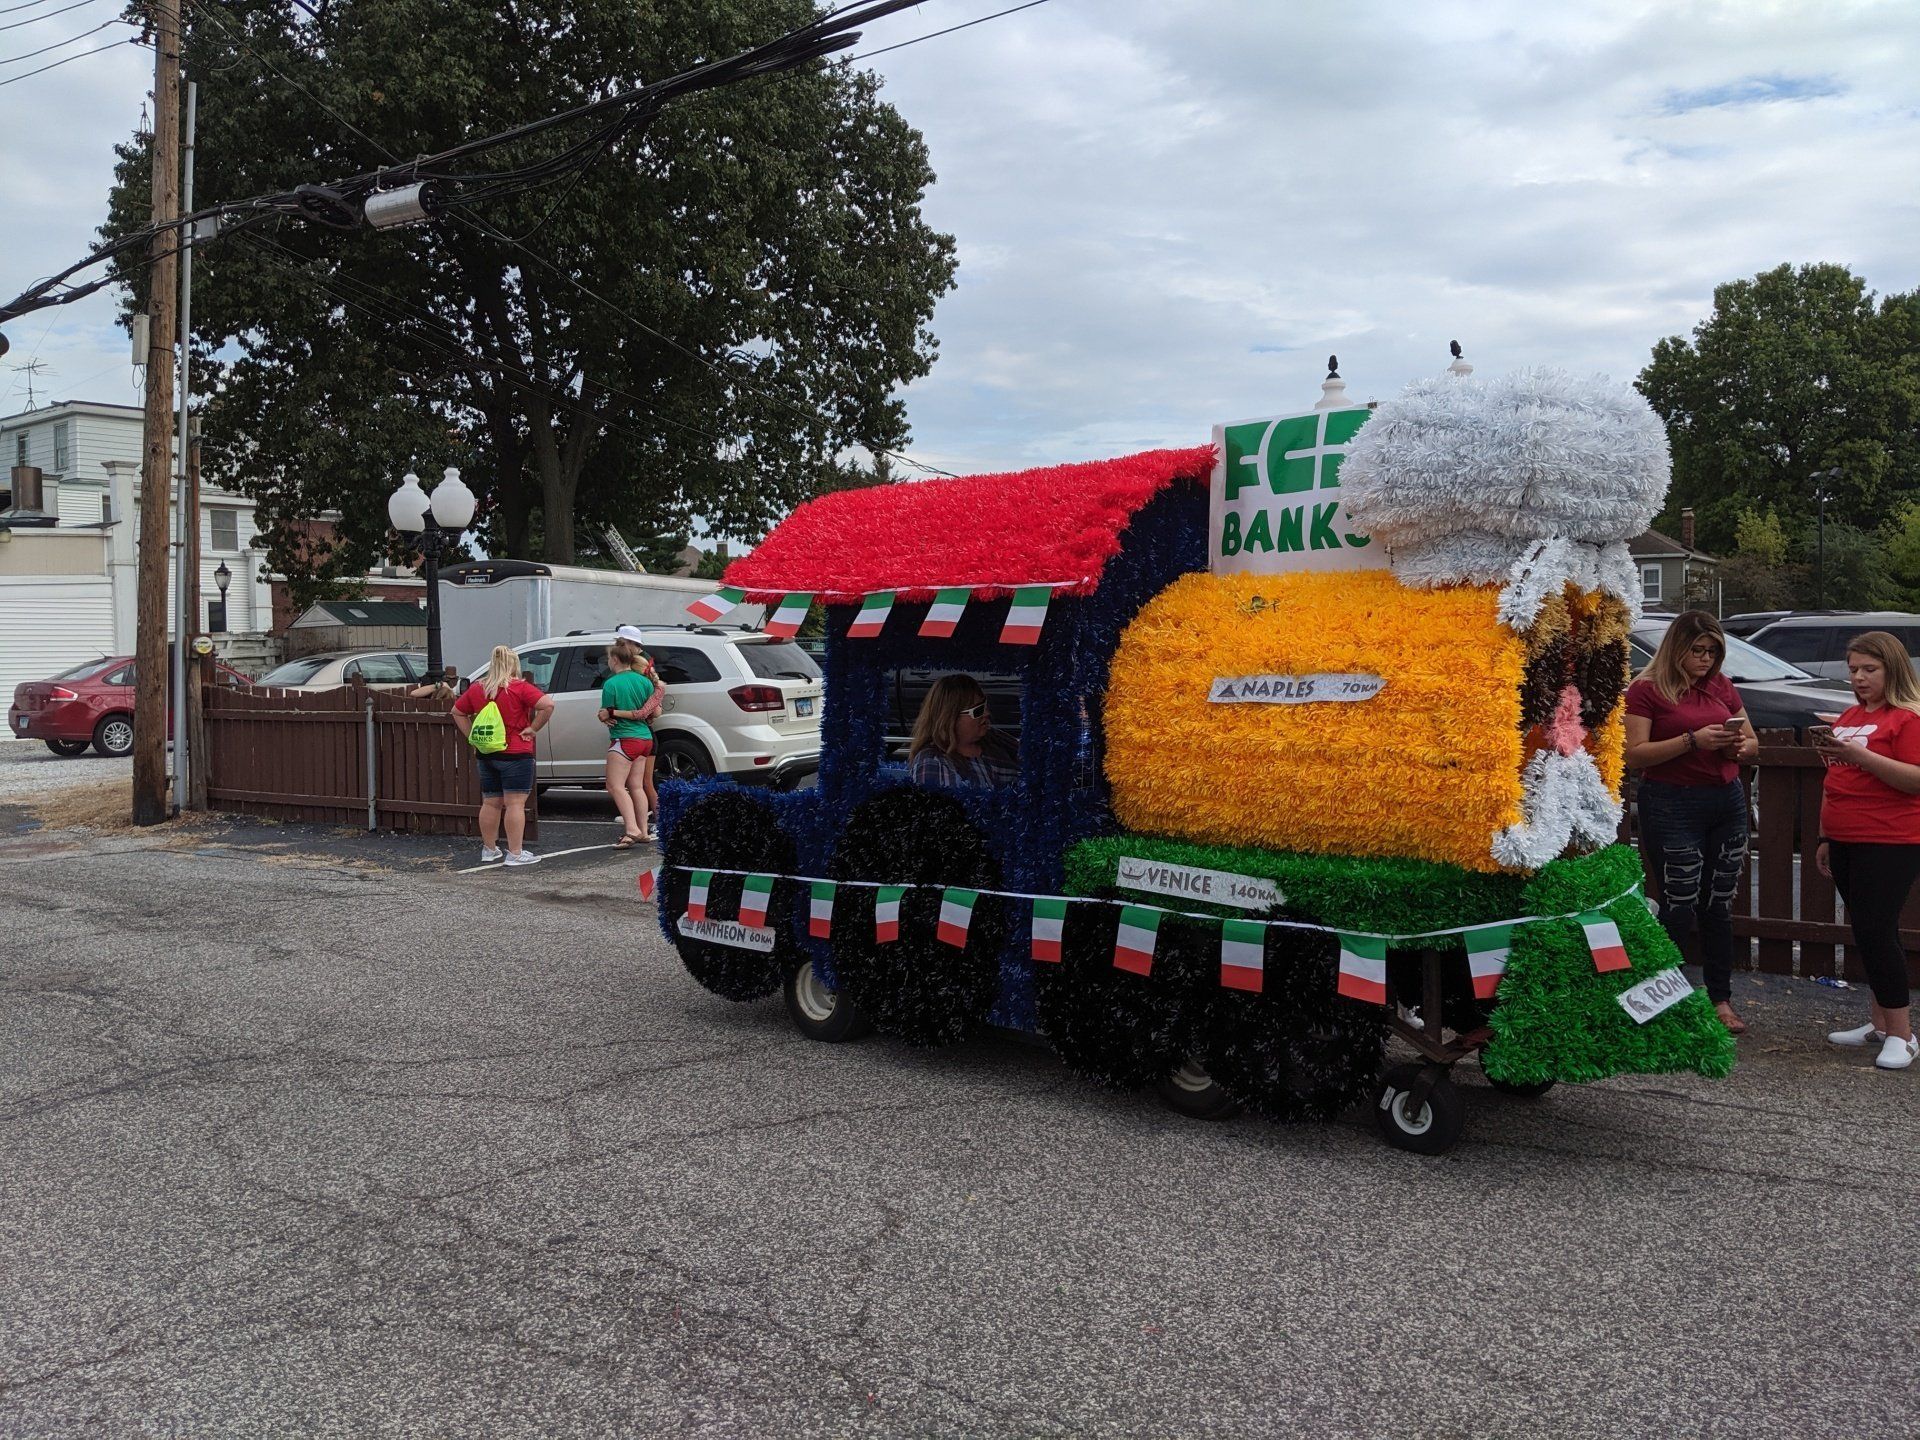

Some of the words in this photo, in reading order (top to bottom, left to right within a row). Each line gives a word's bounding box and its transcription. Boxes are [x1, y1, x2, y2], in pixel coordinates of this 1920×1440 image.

[1241, 680, 1316, 698] NAPLES
[1341, 682, 1378, 694] 70KM
[1147, 867, 1212, 895] VENICE
[1229, 883, 1278, 901] 140KM
[696, 921, 746, 942] PANTHEON
